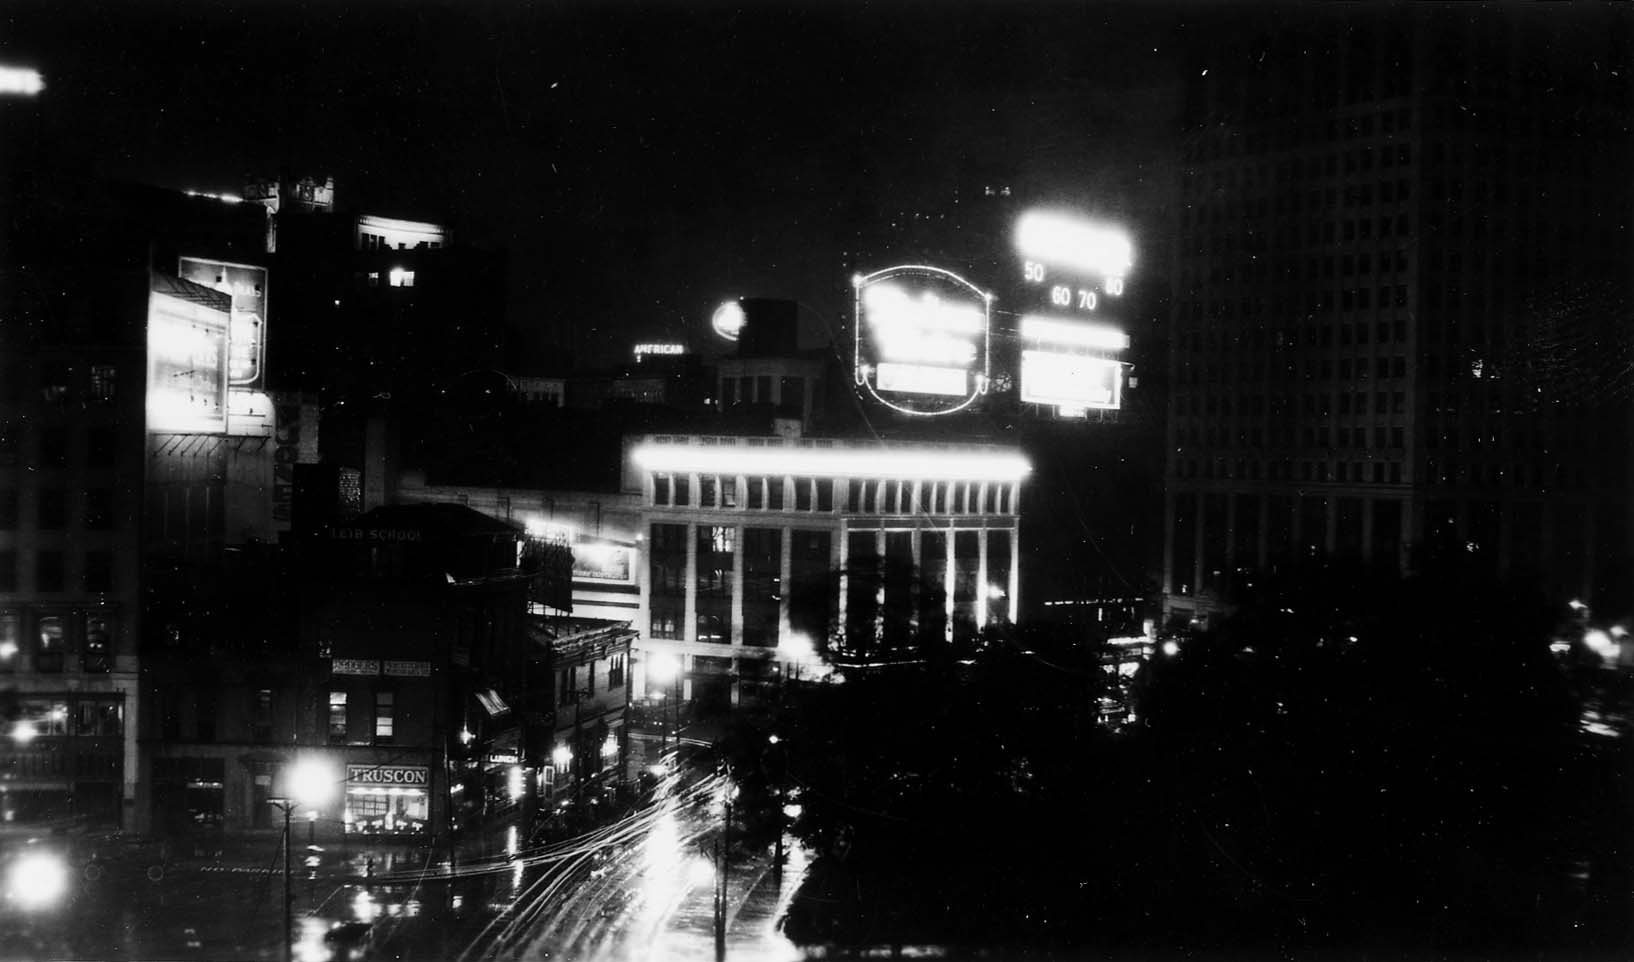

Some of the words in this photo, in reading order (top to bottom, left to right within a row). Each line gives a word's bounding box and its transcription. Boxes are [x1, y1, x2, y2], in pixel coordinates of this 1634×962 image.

[1024, 260, 1044, 282] 50
[1052, 285, 1071, 306] 60
[1078, 289, 1097, 310] 70
[351, 768, 426, 783] TRUSCON
